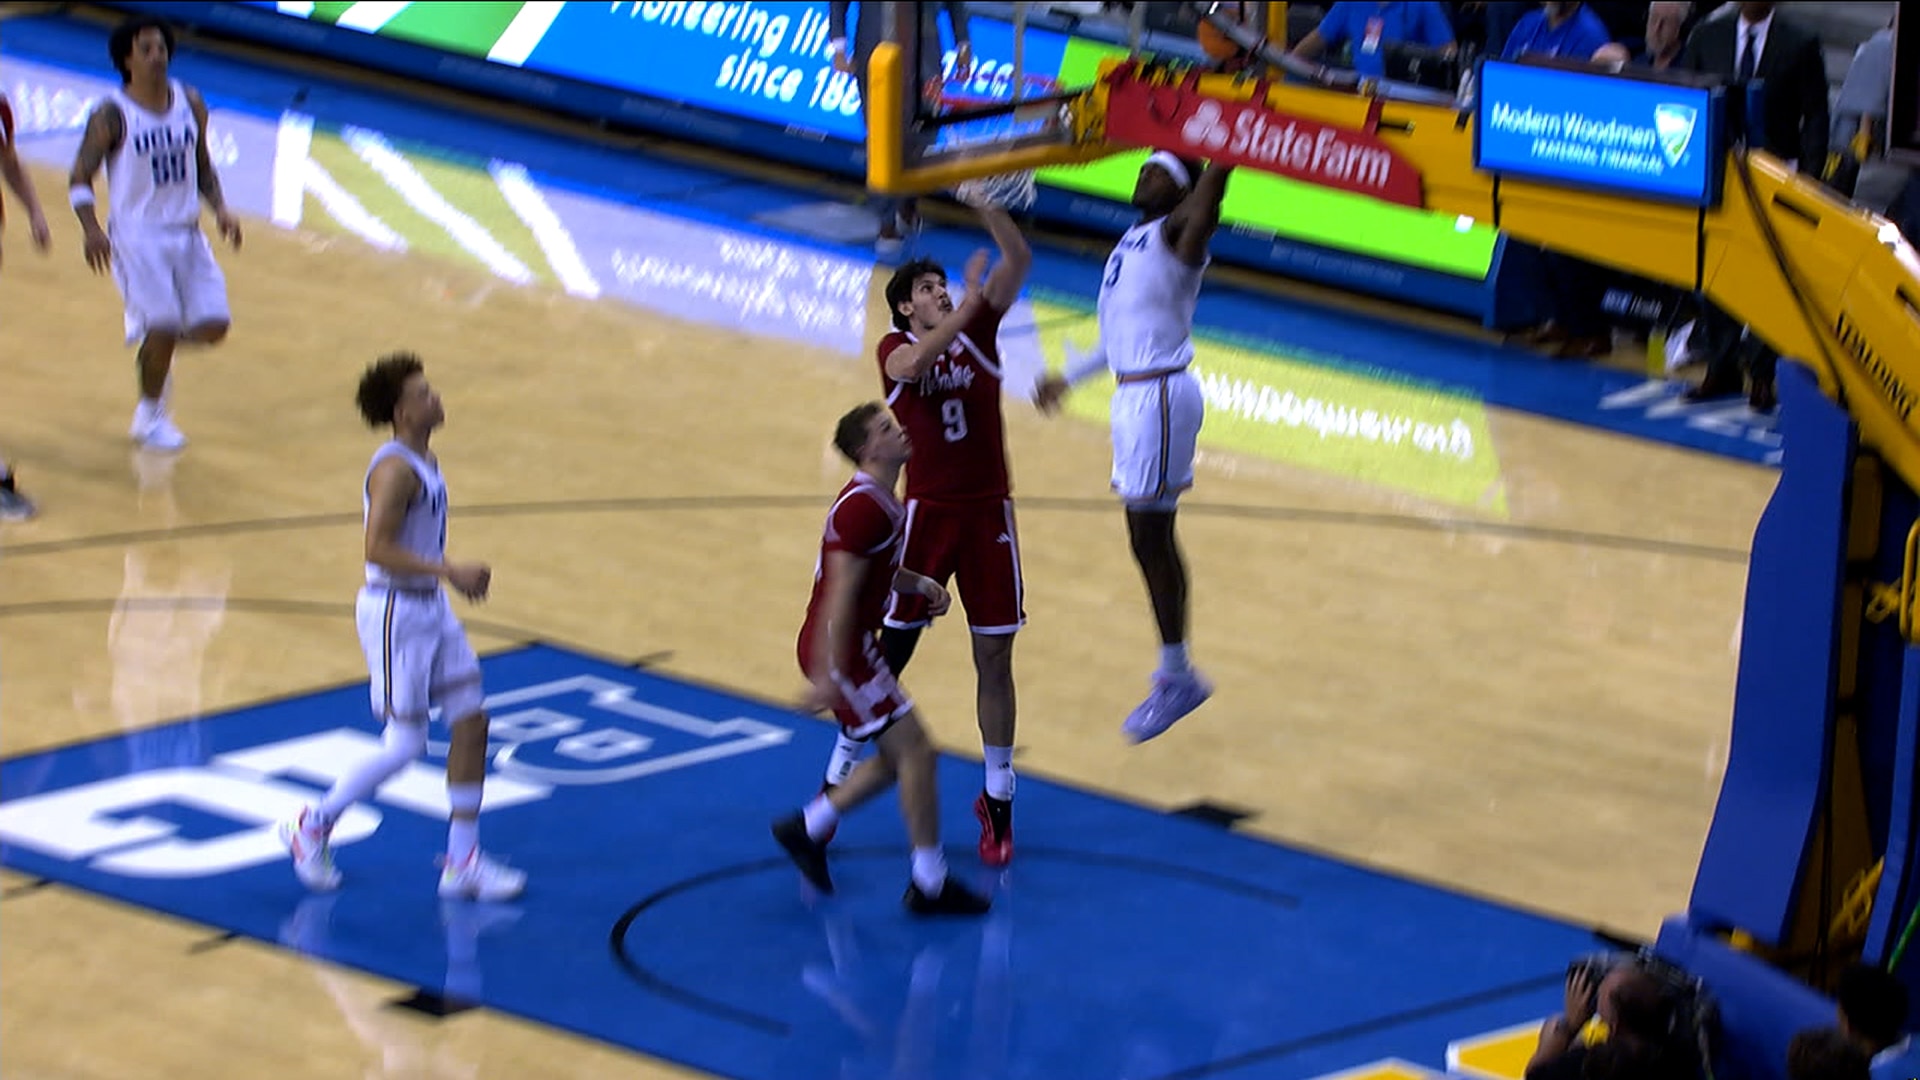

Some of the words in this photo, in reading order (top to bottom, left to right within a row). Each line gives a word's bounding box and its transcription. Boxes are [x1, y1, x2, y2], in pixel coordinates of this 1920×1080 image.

[789, 7, 836, 61] lif
[715, 47, 804, 103] since
[133, 126, 195, 156] UCLA
[1490, 100, 1562, 139] Modern
[1563, 111, 1657, 153] Woodmen
[941, 398, 968, 442] 9
